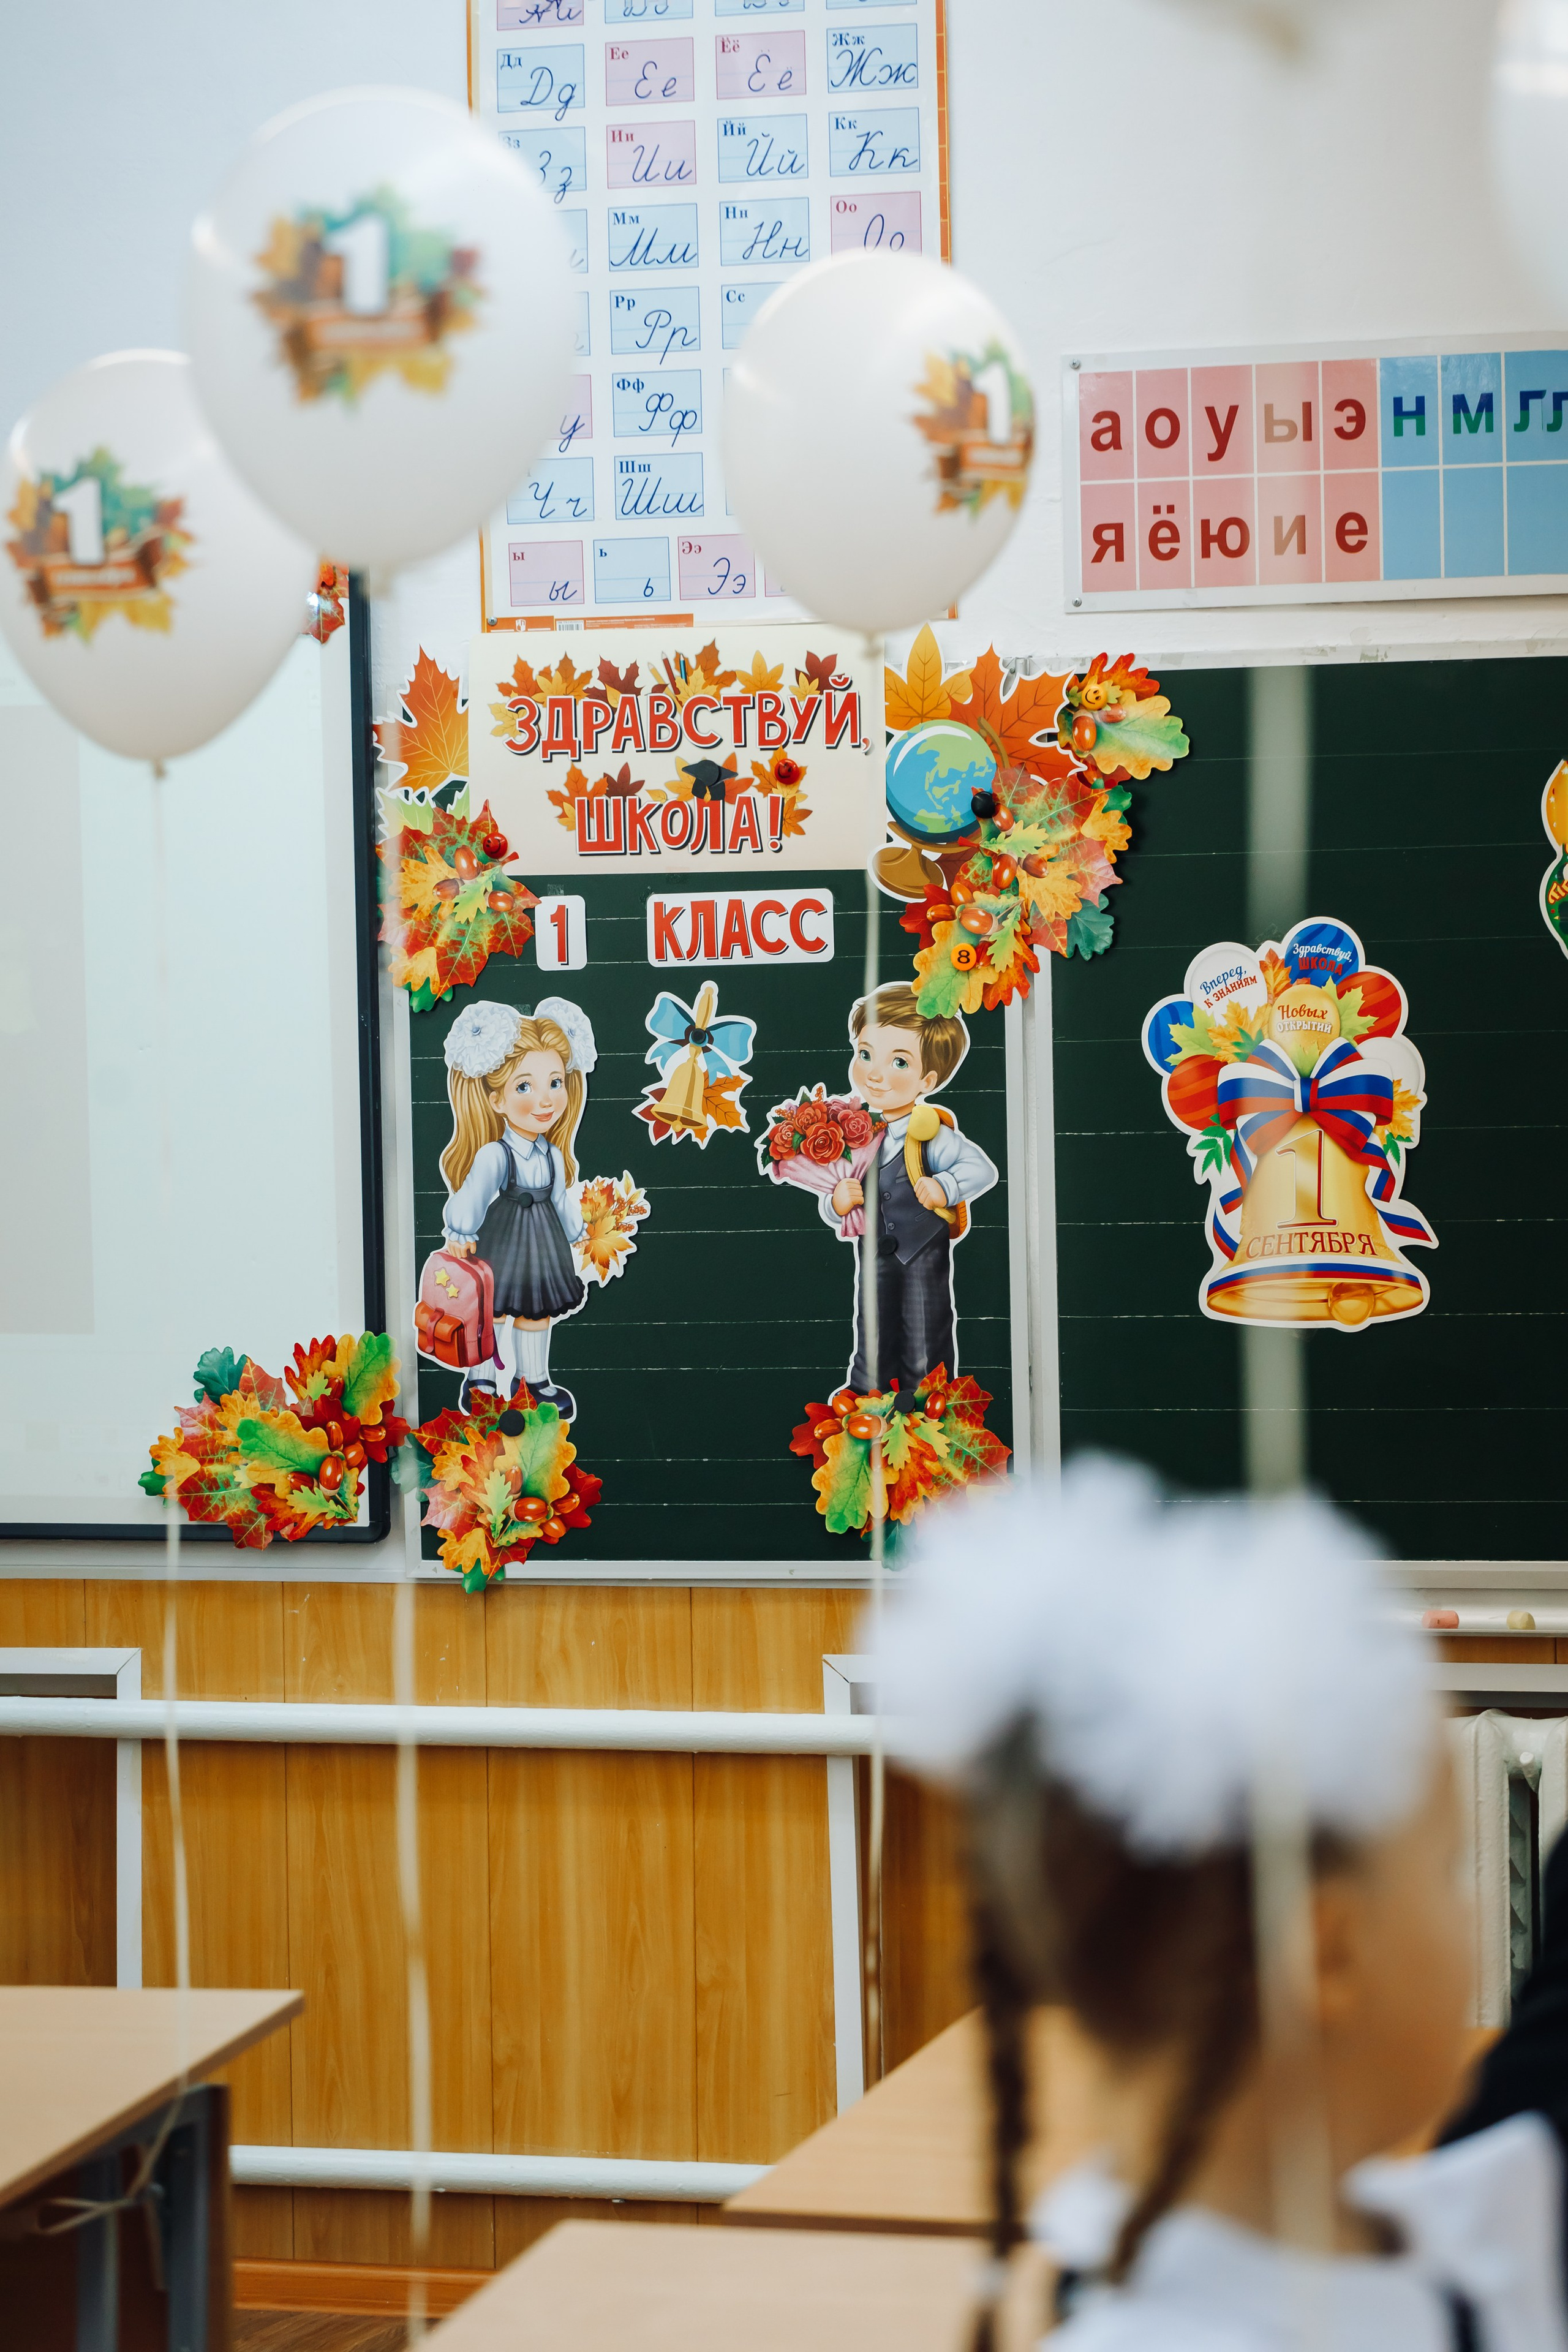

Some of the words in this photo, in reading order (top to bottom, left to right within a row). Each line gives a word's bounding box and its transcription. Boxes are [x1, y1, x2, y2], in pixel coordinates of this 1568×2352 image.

[721, 37, 741, 53] Ёё
[832, 32, 865, 47] Жж
[500, 53, 522, 70] Дд
[610, 47, 629, 60] Ее
[723, 121, 747, 137] Йй
[835, 116, 858, 130] Кк
[611, 130, 635, 143] Ии
[725, 206, 748, 219] Нн
[835, 200, 858, 214] Оо
[612, 212, 639, 225] Мм
[322, 213, 387, 316] 1
[614, 295, 636, 311] Рр
[726, 290, 745, 303] Сс
[616, 378, 645, 393] Фф
[1090, 410, 1123, 453] а
[1145, 407, 1180, 450] о
[1204, 405, 1239, 462] у
[1264, 401, 1313, 443] ы
[1333, 398, 1366, 441] э
[1393, 395, 1427, 437] н
[1452, 393, 1494, 434] м
[619, 461, 651, 474] Шш
[48, 477, 105, 564] 1
[1090, 522, 1125, 564] я
[1148, 504, 1181, 562] ё
[1200, 516, 1251, 559] ю
[1273, 514, 1306, 556] и
[1335, 511, 1368, 554] е
[599, 548, 608, 557] ь
[682, 541, 702, 554] Ээ
[512, 552, 526, 561] ы
[503, 674, 875, 762] ЗДРАВСТВУЙ,
[575, 793, 785, 857] ШКОЛА!
[549, 903, 570, 966] 1
[653, 897, 828, 963] КЛАСС
[957, 950, 970, 964] 8
[1293, 943, 1352, 963] Здравствуй,
[1298, 957, 1343, 976] ШКОЛА
[1200, 965, 1246, 995] Вперед,
[1213, 975, 1257, 1001] ЗНАНИЯМ
[1278, 1004, 1328, 1020] Новых
[1276, 1020, 1332, 1034] ОТКРЫТИЙ
[1275, 1129, 1338, 1230] 1
[1246, 1231, 1379, 1259] СЕНТЯБРЯ
